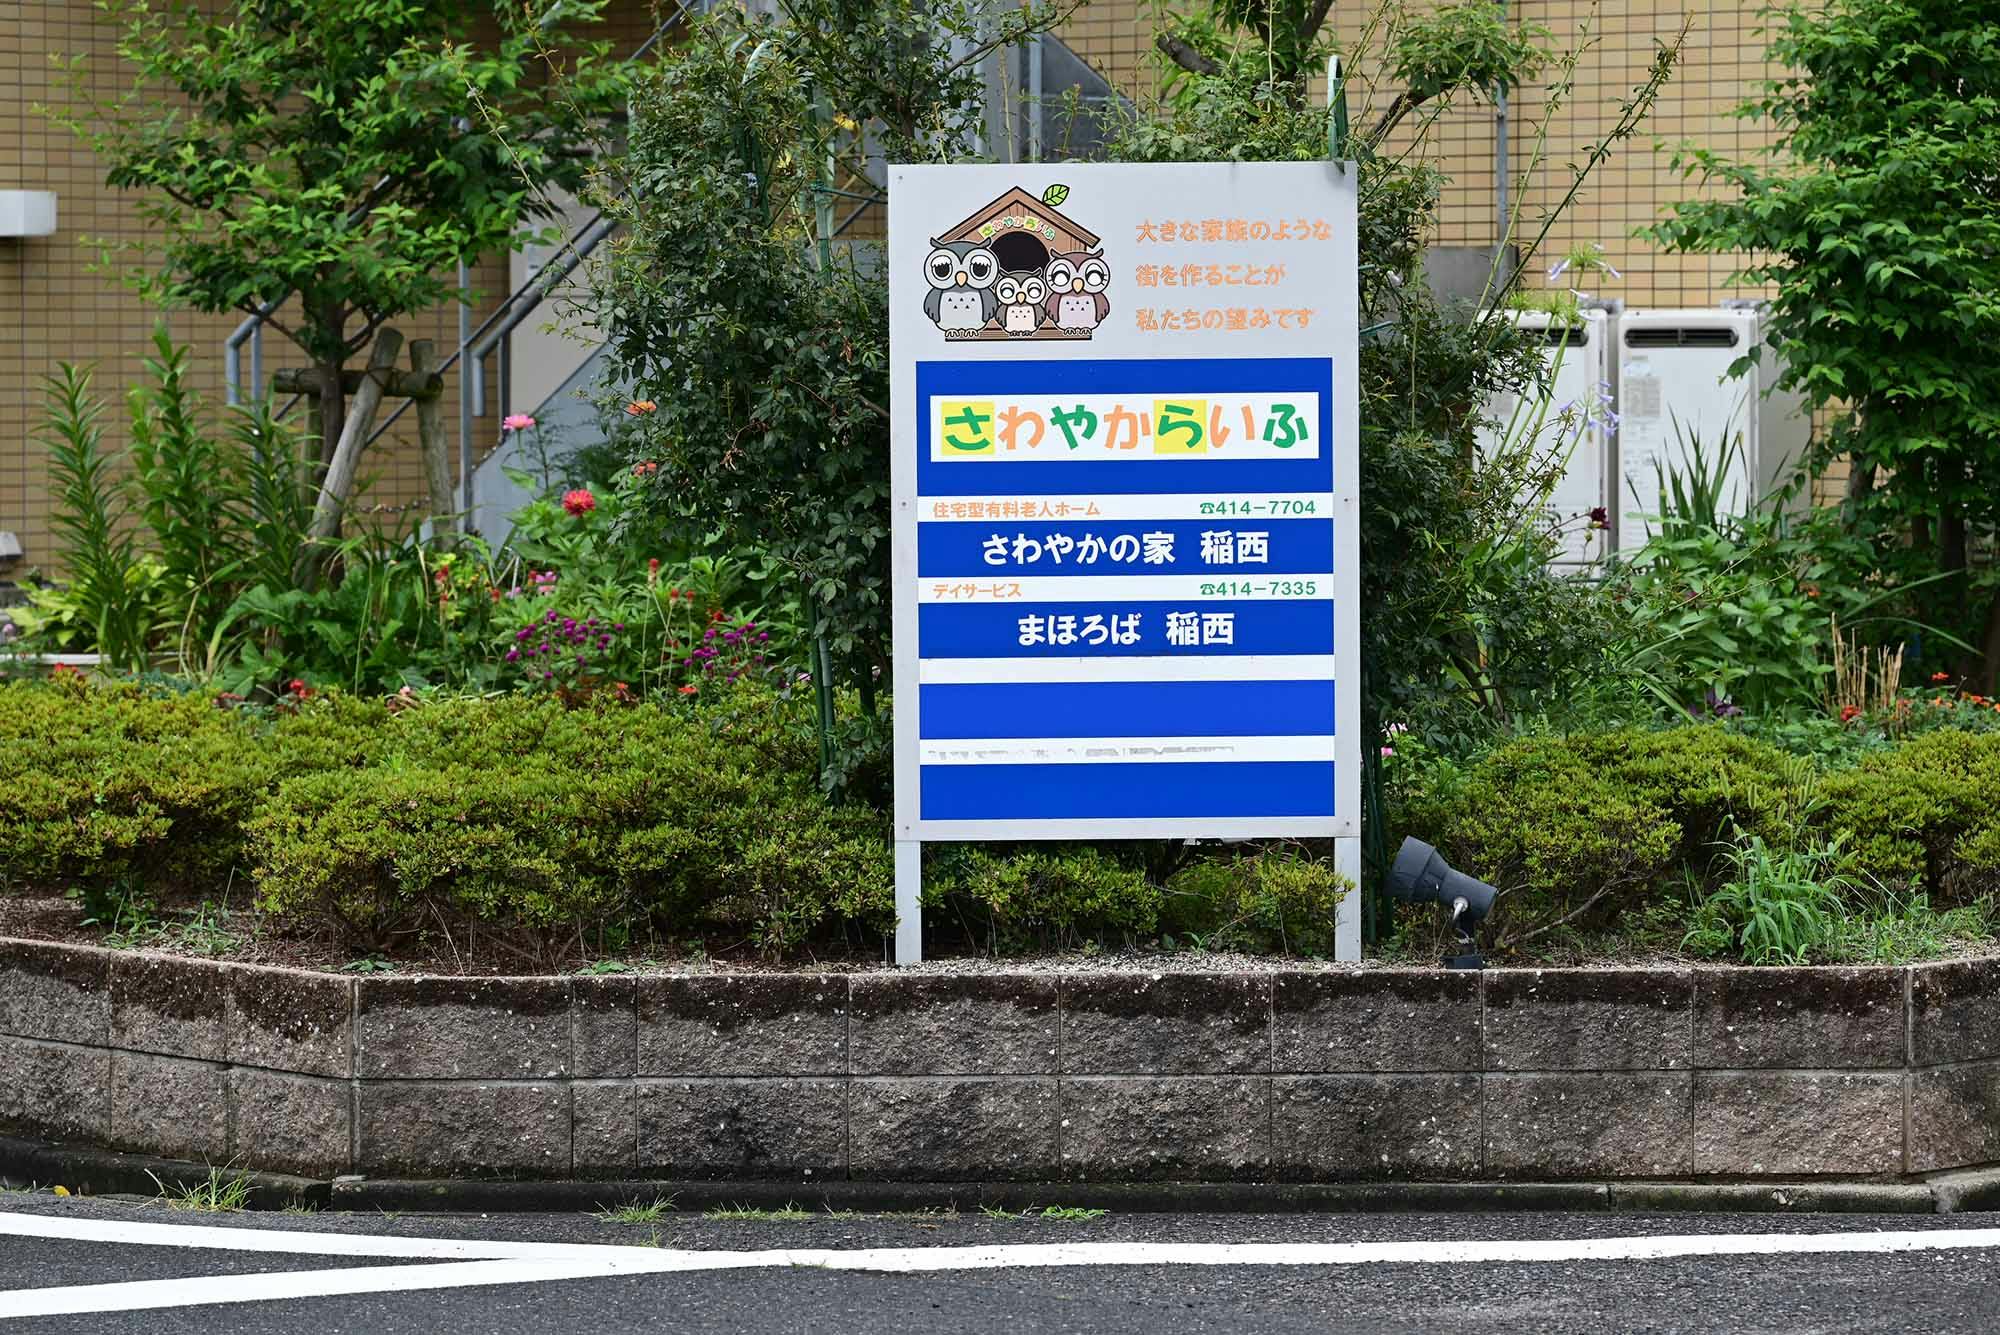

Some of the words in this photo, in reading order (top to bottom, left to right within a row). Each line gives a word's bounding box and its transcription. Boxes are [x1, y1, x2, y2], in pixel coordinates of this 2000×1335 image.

[1135, 219, 1333, 242] 大きな家族のような
[1135, 264, 1286, 288] 街を作ることが
[1135, 307, 1314, 332] 私たちの望みです
[943, 402, 1309, 450] さわやからいふ
[932, 501, 1101, 518] 住宅型有料老人ホーム
[982, 530, 1176, 566] さわやかの家
[1200, 529, 1270, 565] 稲西
[932, 583, 1022, 598] デイサービス
[1017, 612, 1142, 646] まほろば
[1165, 611, 1235, 646] 稲西
